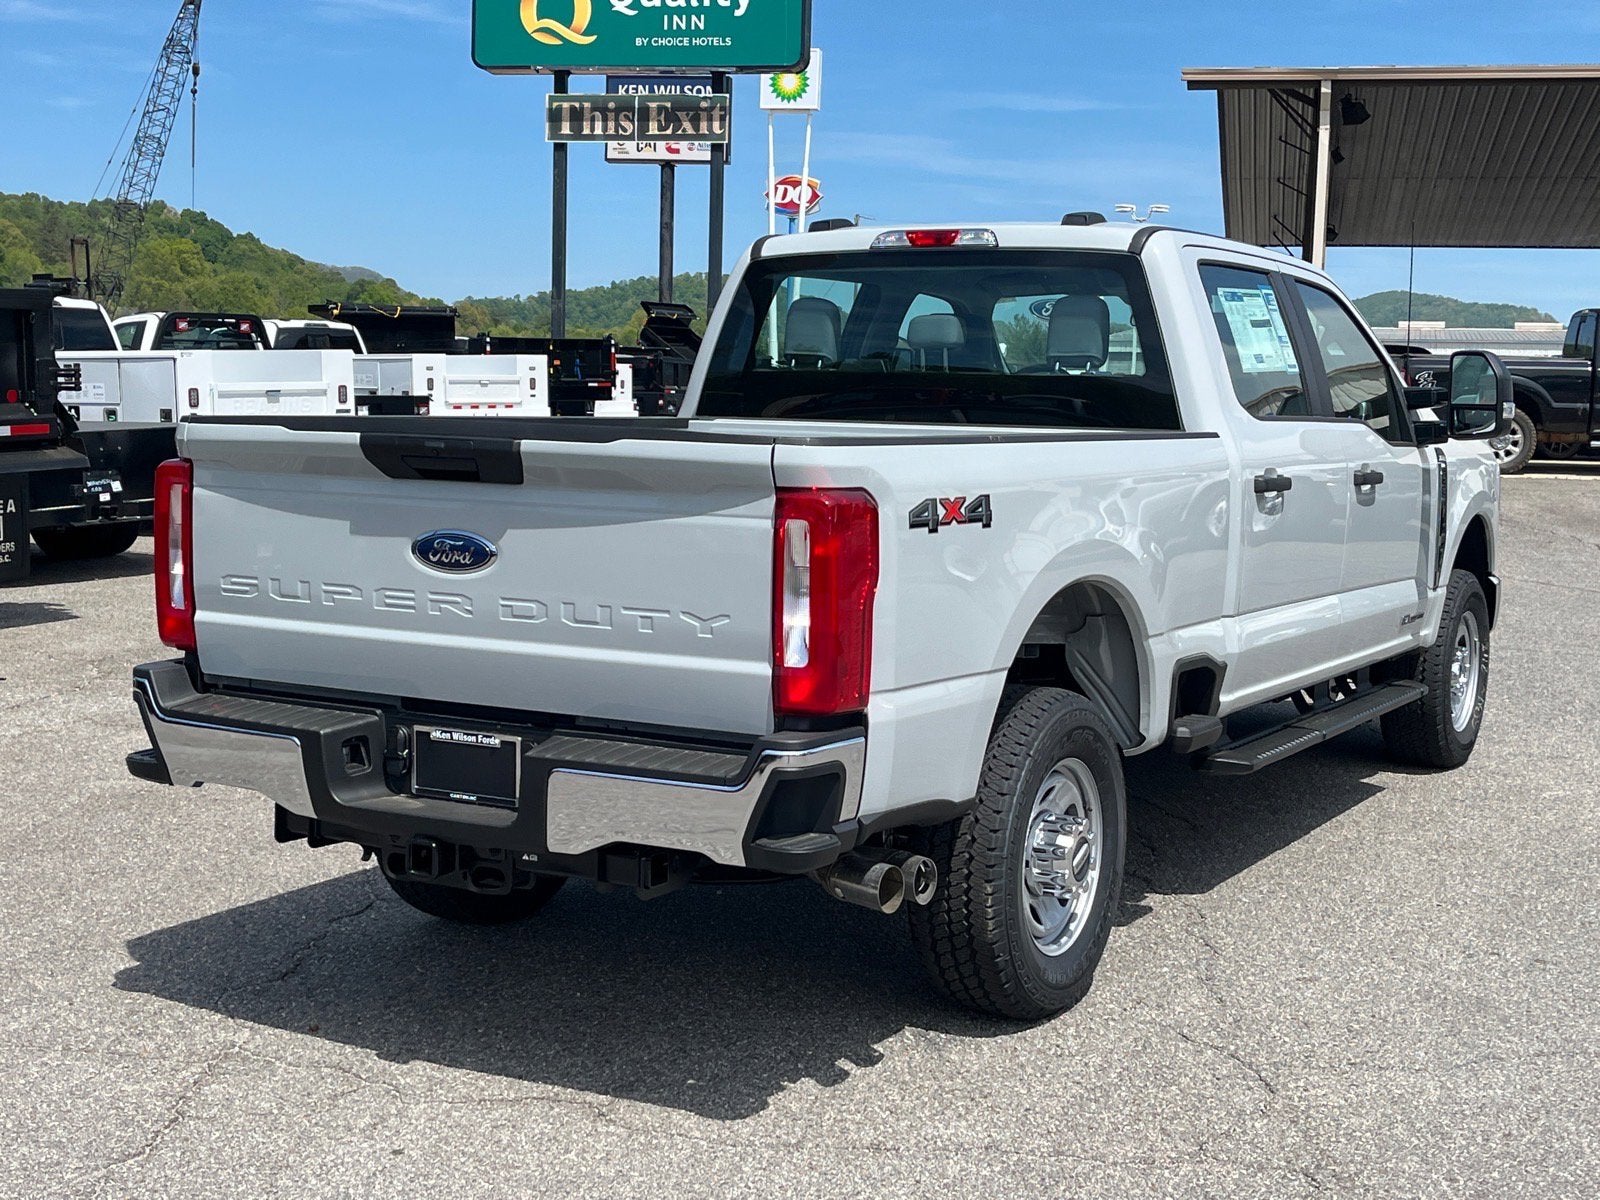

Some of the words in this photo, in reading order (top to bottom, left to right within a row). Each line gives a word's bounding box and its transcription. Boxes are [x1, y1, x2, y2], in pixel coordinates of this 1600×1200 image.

[663, 14, 705, 31] INN
[635, 37, 649, 46] BY
[651, 37, 690, 46] CHOICE
[692, 37, 732, 46] HOTELS
[618, 84, 649, 96] KEN
[552, 101, 634, 136] This
[645, 101, 726, 135] Exit
[774, 184, 813, 207] DQ
[428, 538, 476, 565] Ford
[220, 574, 474, 618] SUPER
[499, 597, 731, 638] DUTY
[436, 730, 451, 741] Ken
[451, 731, 477, 743] Wilson
[477, 734, 495, 745] Ford
